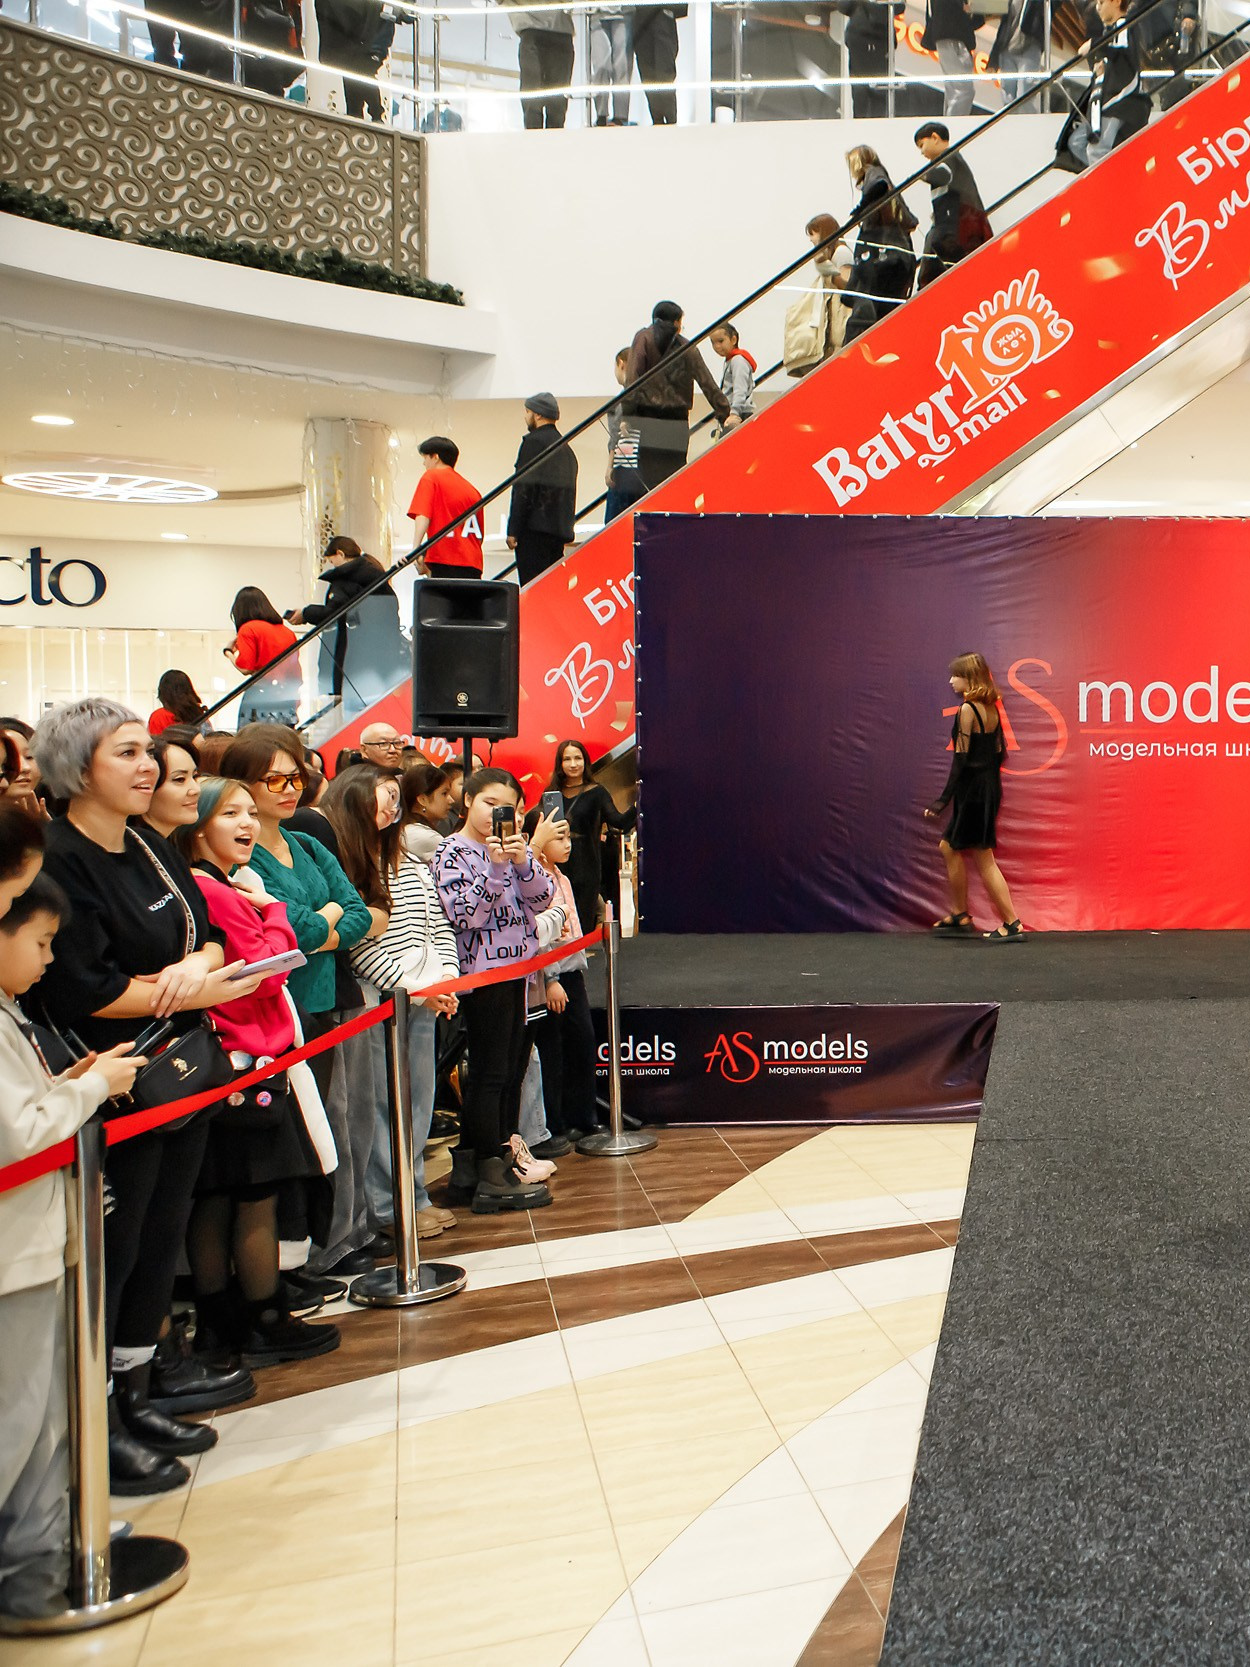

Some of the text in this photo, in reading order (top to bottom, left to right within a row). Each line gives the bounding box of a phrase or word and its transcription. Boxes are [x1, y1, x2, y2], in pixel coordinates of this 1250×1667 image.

[953, 382, 1028, 446] mall
[812, 383, 960, 508] Batyr
[1089, 740, 1217, 761] модельная
[485, 937, 528, 960] LOUIS
[704, 1031, 869, 1083] AS models
[636, 1068, 670, 1076] школа
[768, 1065, 862, 1076] модельная школа
